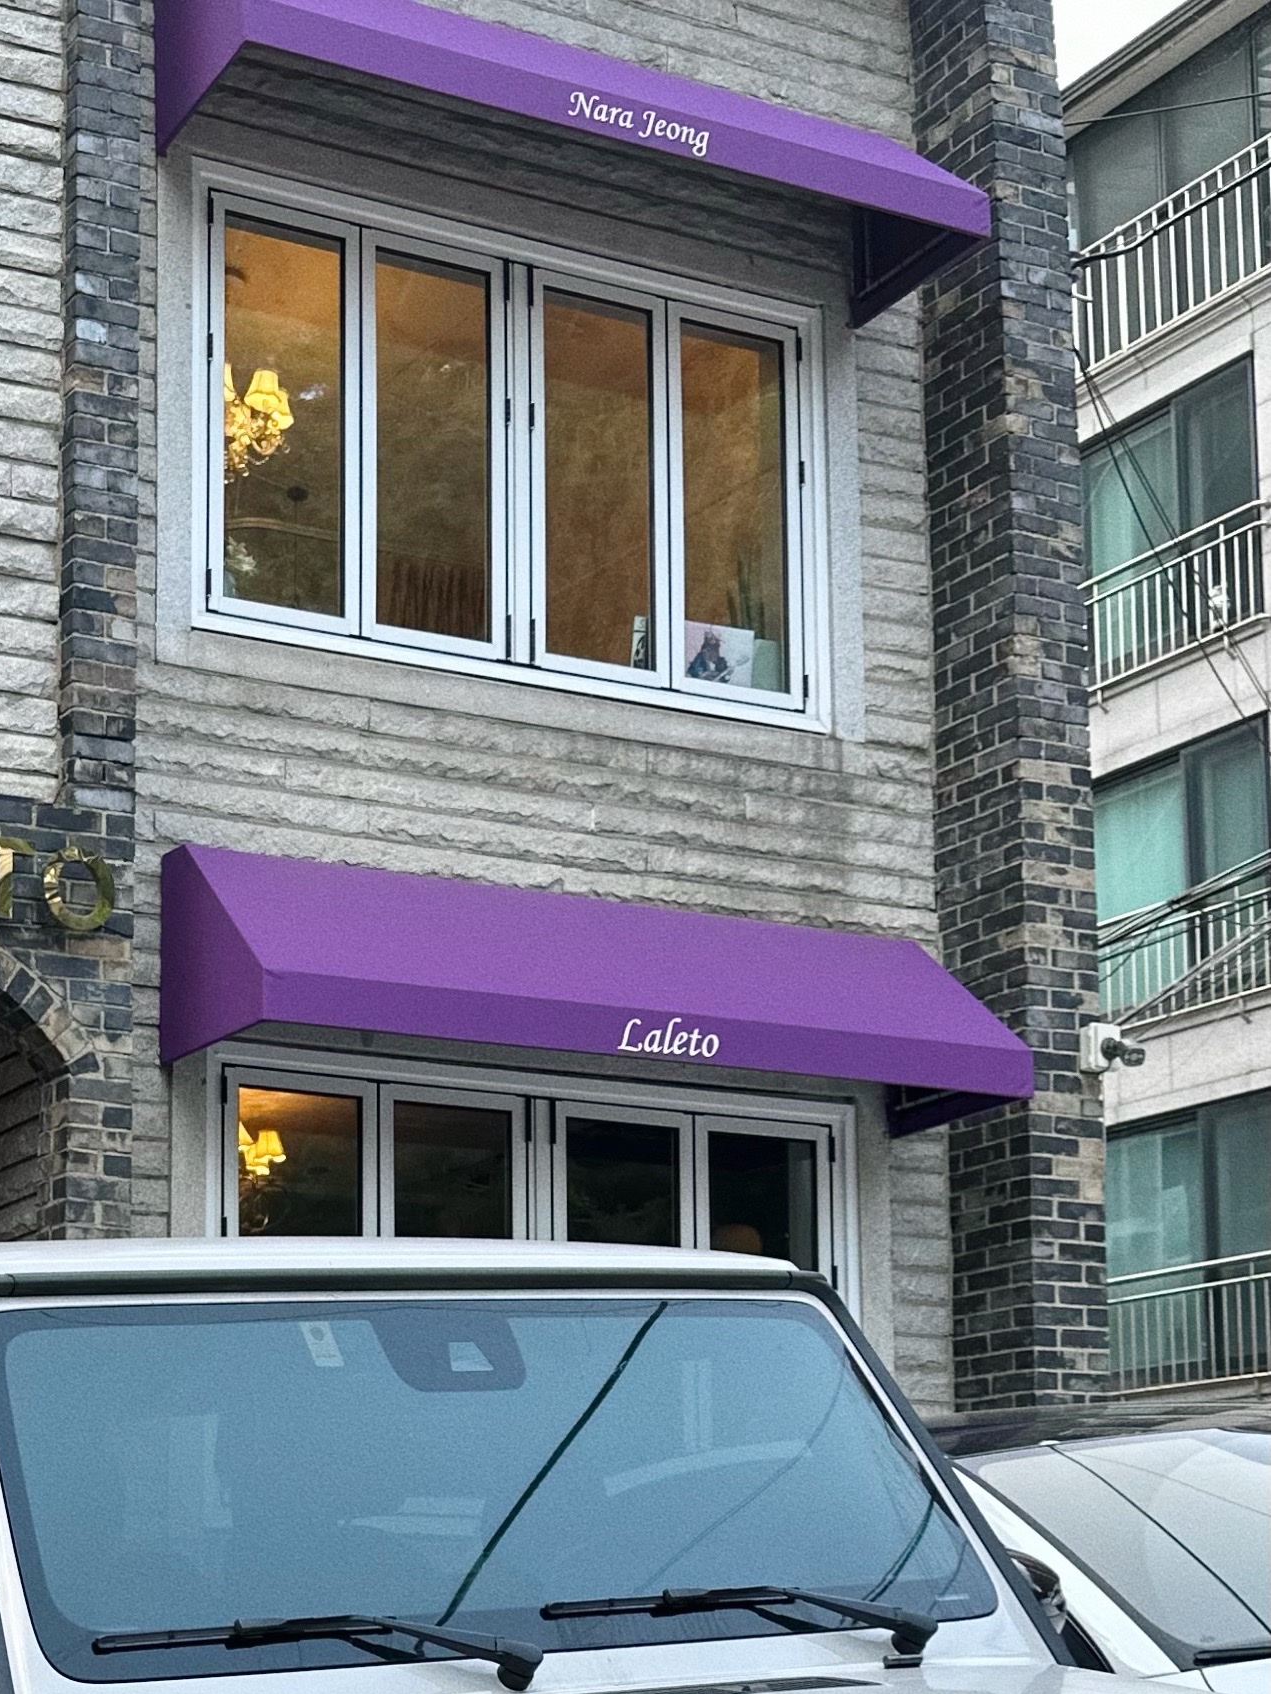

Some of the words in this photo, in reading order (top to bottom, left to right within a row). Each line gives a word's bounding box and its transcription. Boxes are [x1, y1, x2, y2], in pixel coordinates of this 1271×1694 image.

[567, 91, 634, 129] Nara
[637, 110, 710, 157] Jeong
[617, 1017, 720, 1058] Laleto
